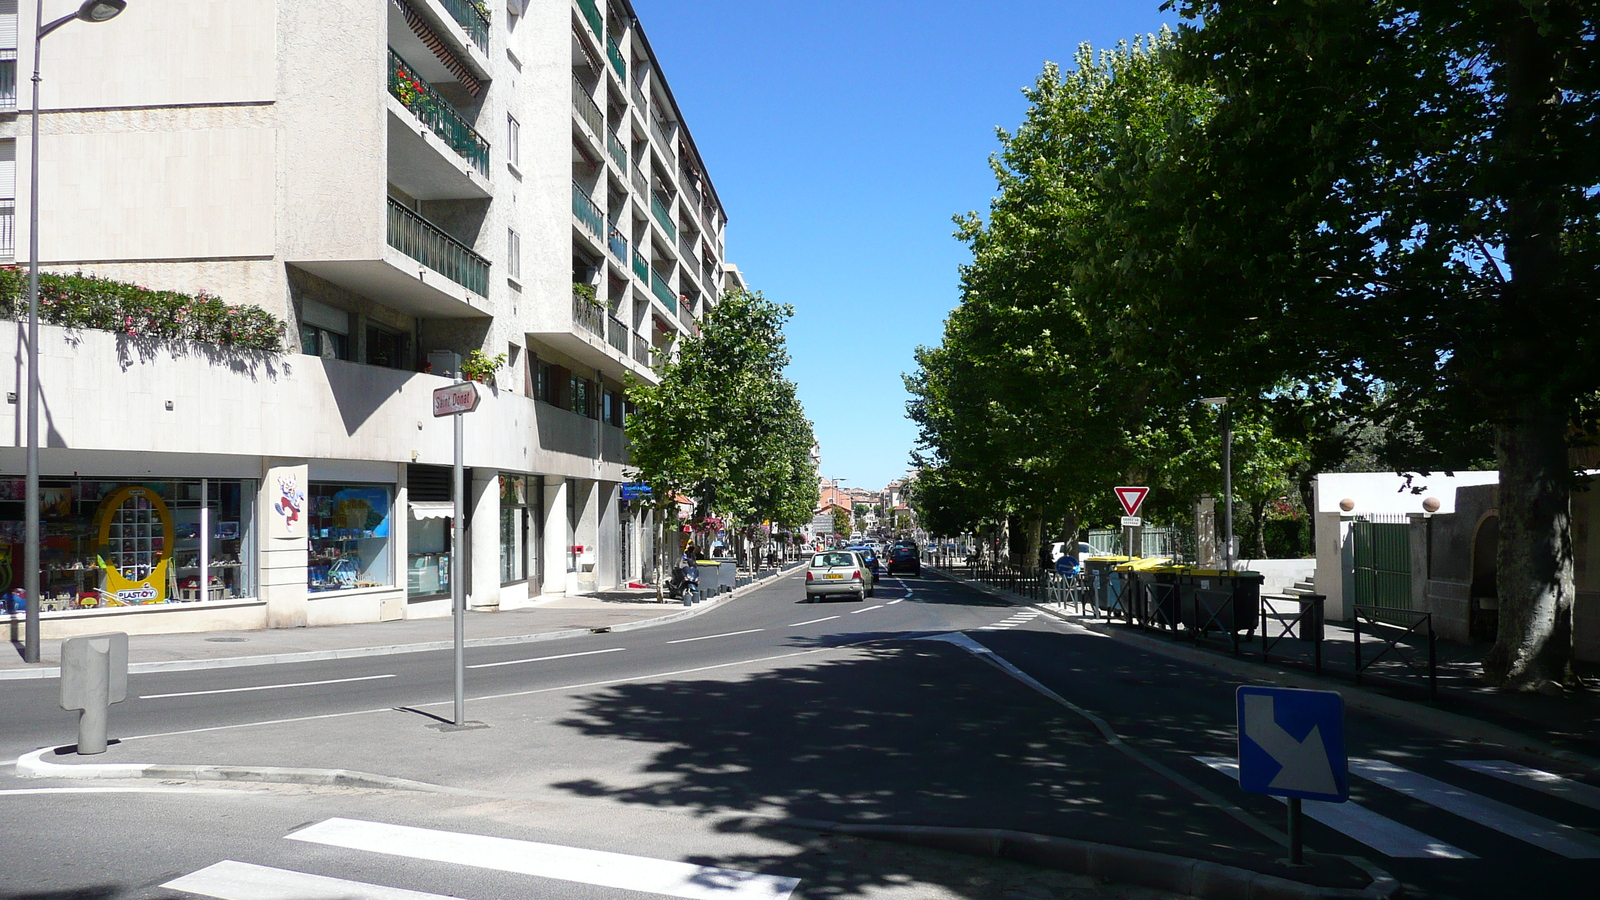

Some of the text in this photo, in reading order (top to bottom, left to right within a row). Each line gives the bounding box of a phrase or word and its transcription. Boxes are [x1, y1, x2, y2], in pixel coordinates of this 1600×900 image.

[435, 392, 470, 409] Saint Donat
[118, 590, 154, 599] PLASTOY
